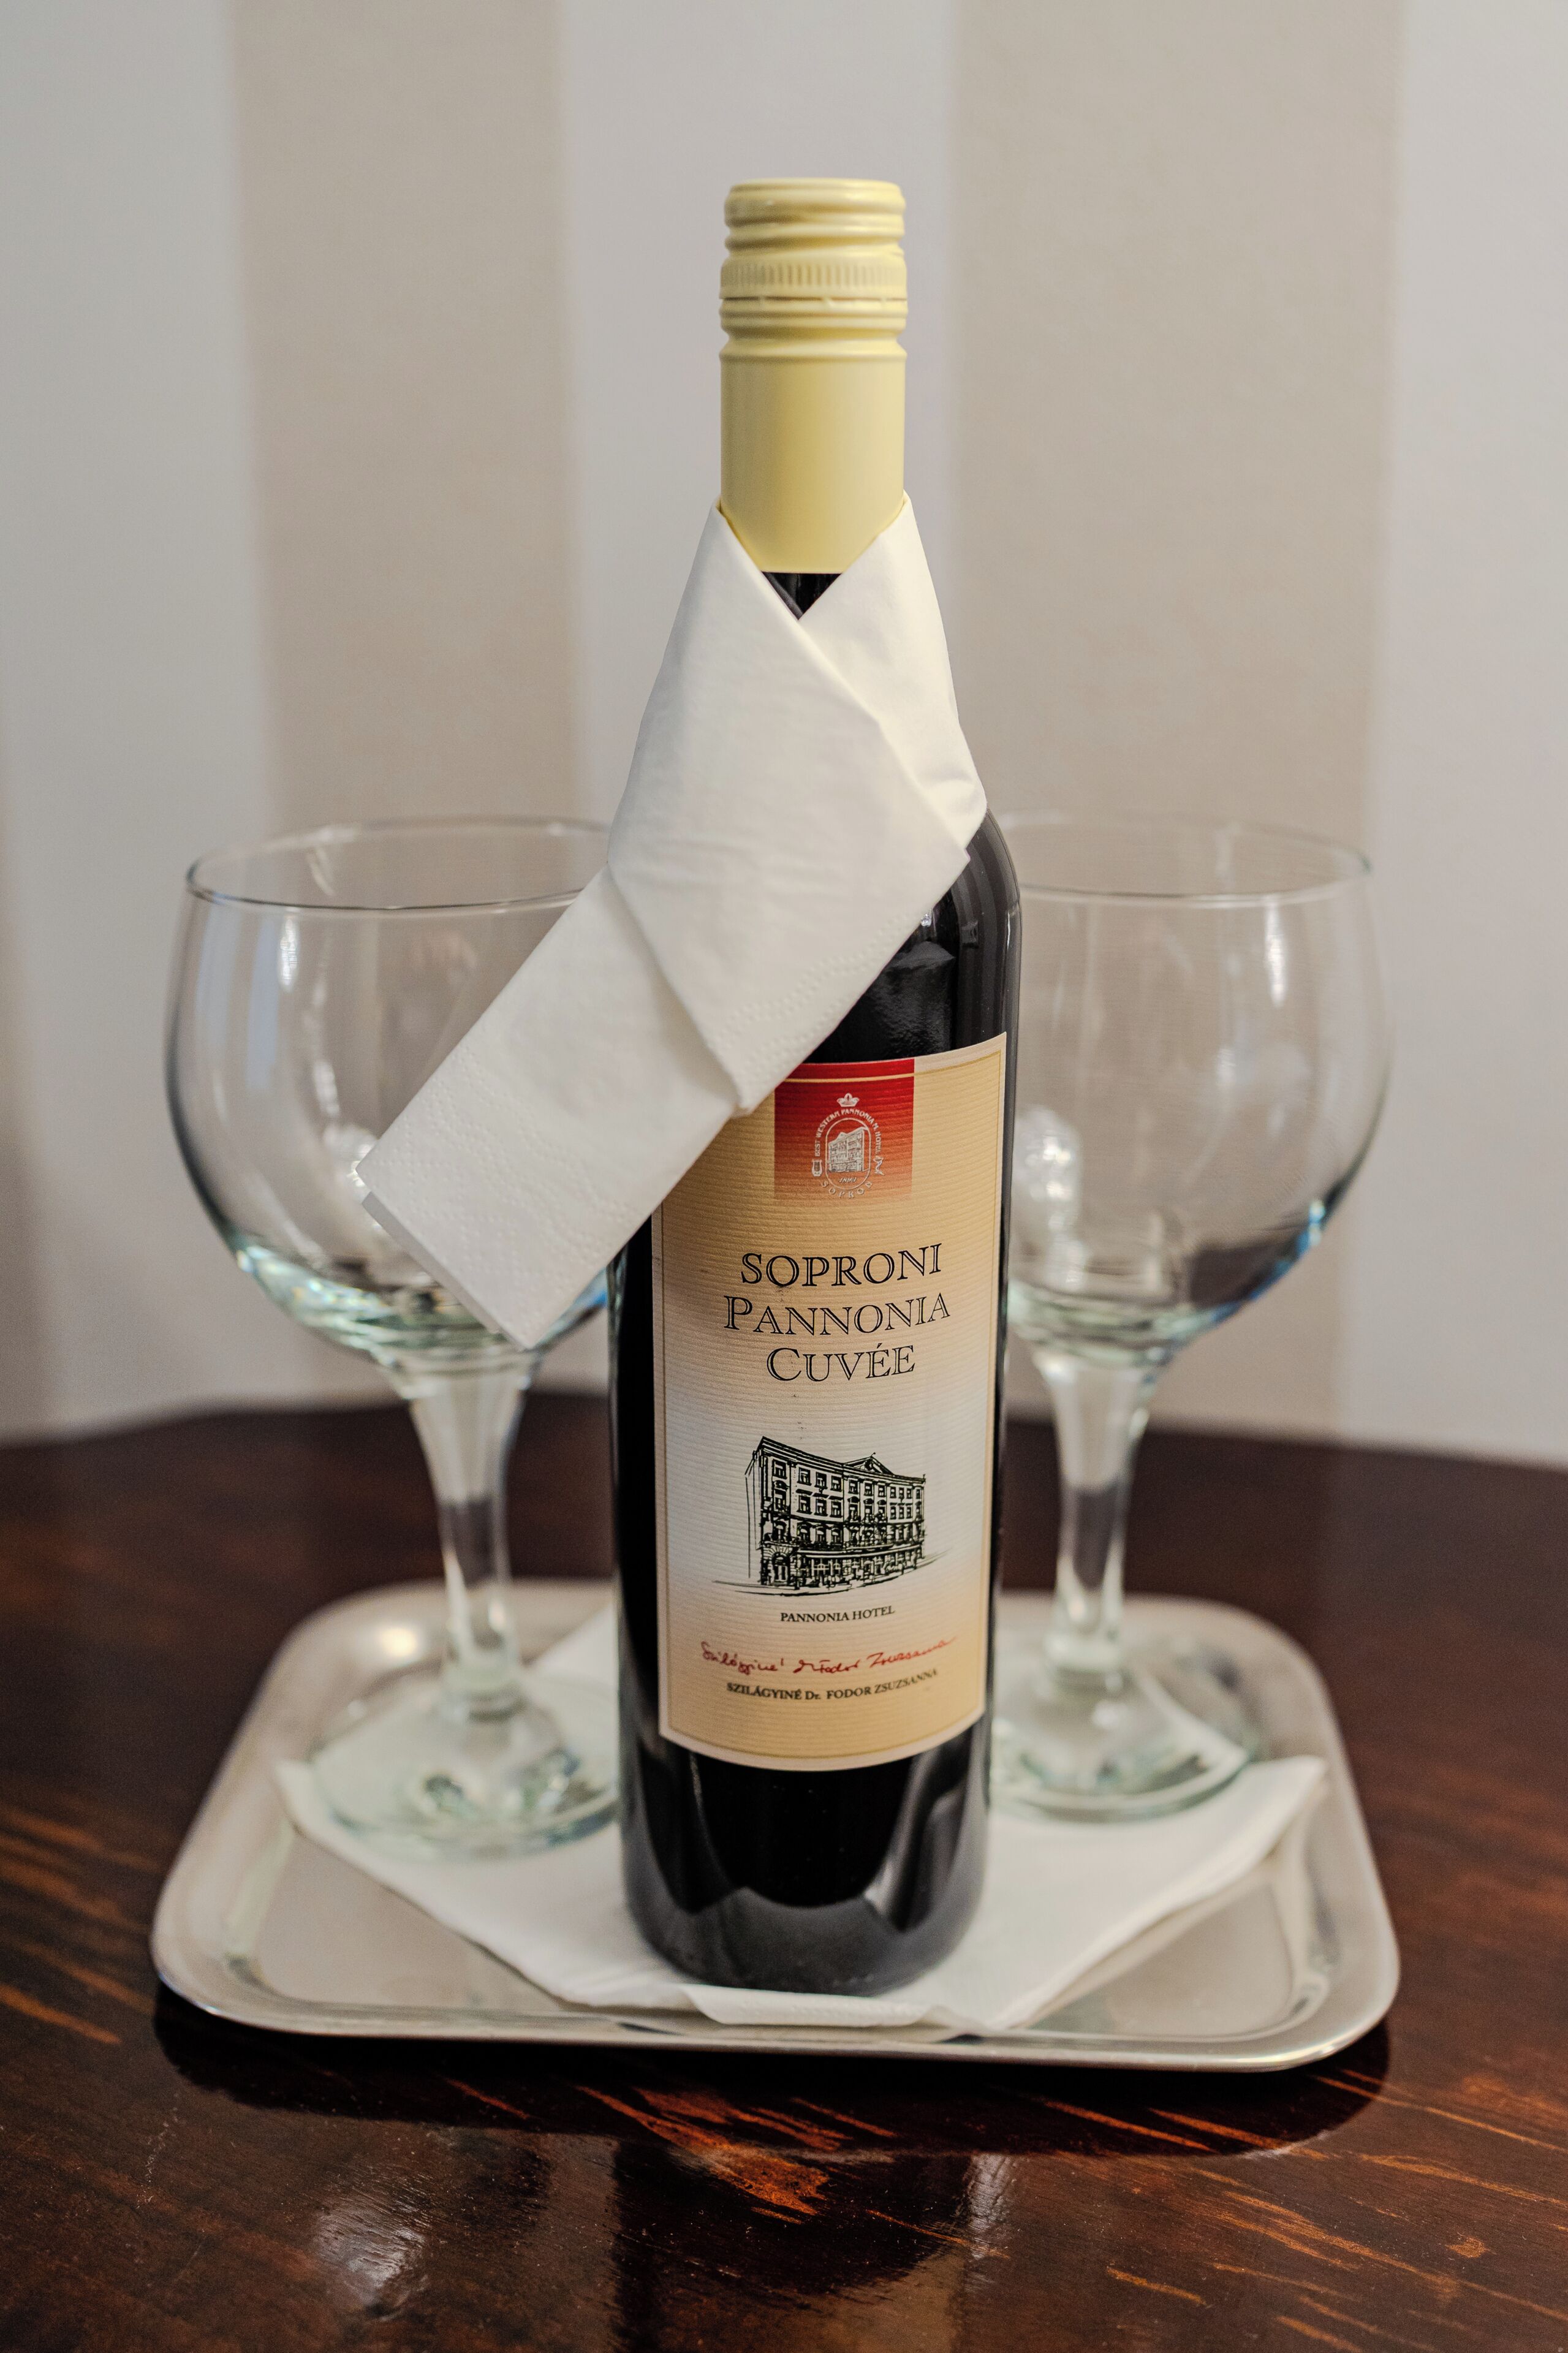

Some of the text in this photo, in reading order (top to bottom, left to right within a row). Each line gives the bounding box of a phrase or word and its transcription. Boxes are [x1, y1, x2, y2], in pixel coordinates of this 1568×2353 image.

[841, 1108, 875, 1124] PANNONIA
[741, 1243, 942, 1287] SOPRONI
[724, 1292, 950, 1336] PANNONIA
[767, 1343, 915, 1382] CUVÉE
[780, 1605, 895, 1623] PANNONIA HOTEL
[726, 1667, 938, 1700] SZILÁGYINÉ Dr. FODOR ZSUZSANNA
